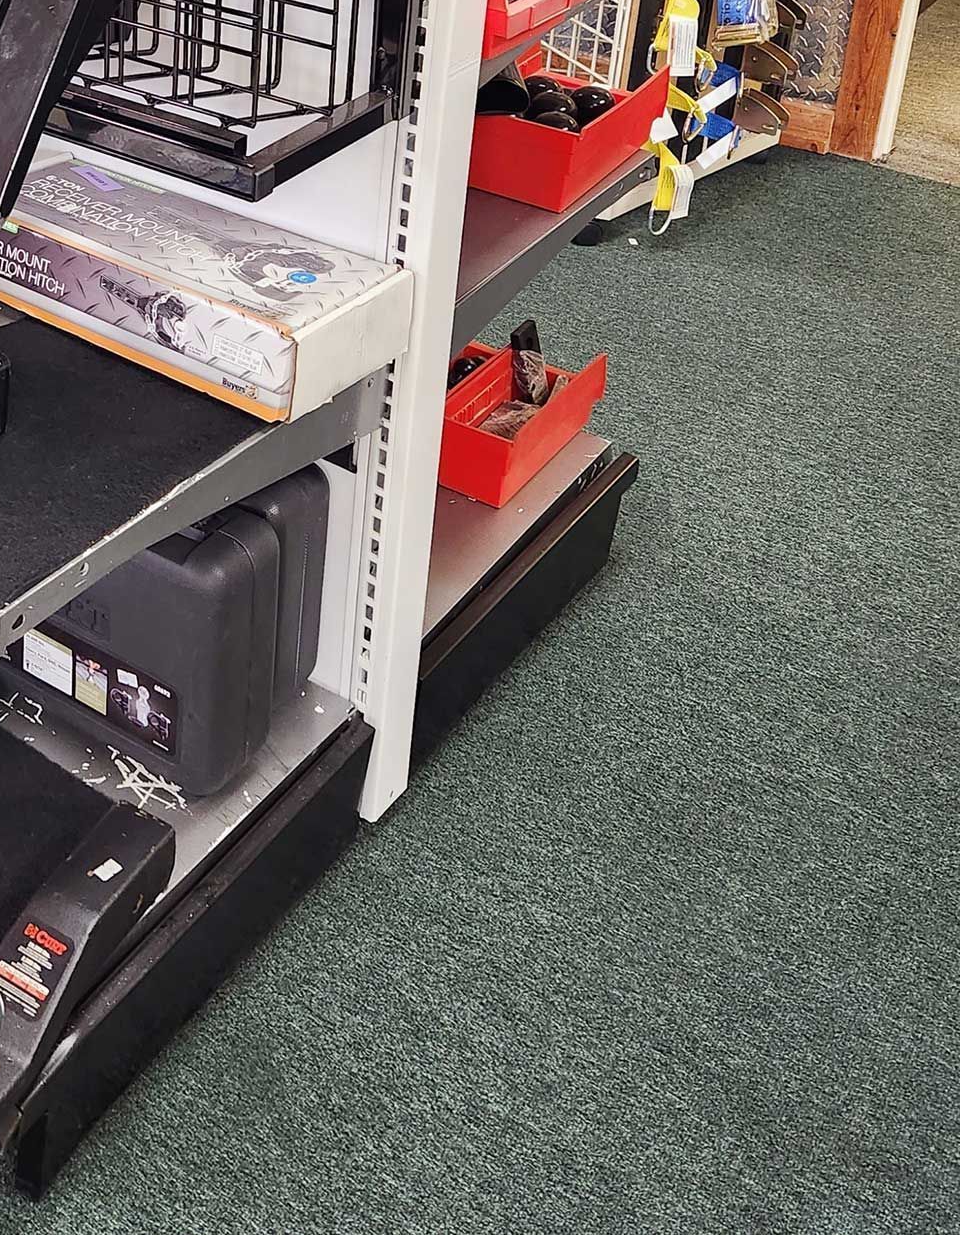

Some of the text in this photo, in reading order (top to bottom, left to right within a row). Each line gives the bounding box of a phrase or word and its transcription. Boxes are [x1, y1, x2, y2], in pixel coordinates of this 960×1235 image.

[45, 174, 86, 192] 6-TON
[21, 184, 214, 262] COMBINATION HITCH
[30, 179, 123, 217] RECEIVER
[120, 212, 201, 245] MOUNT
[6, 244, 51, 274] MOUNT
[28, 269, 65, 297] HITCH
[222, 377, 246, 392] Buyers
[36, 929, 69, 956] CURT
